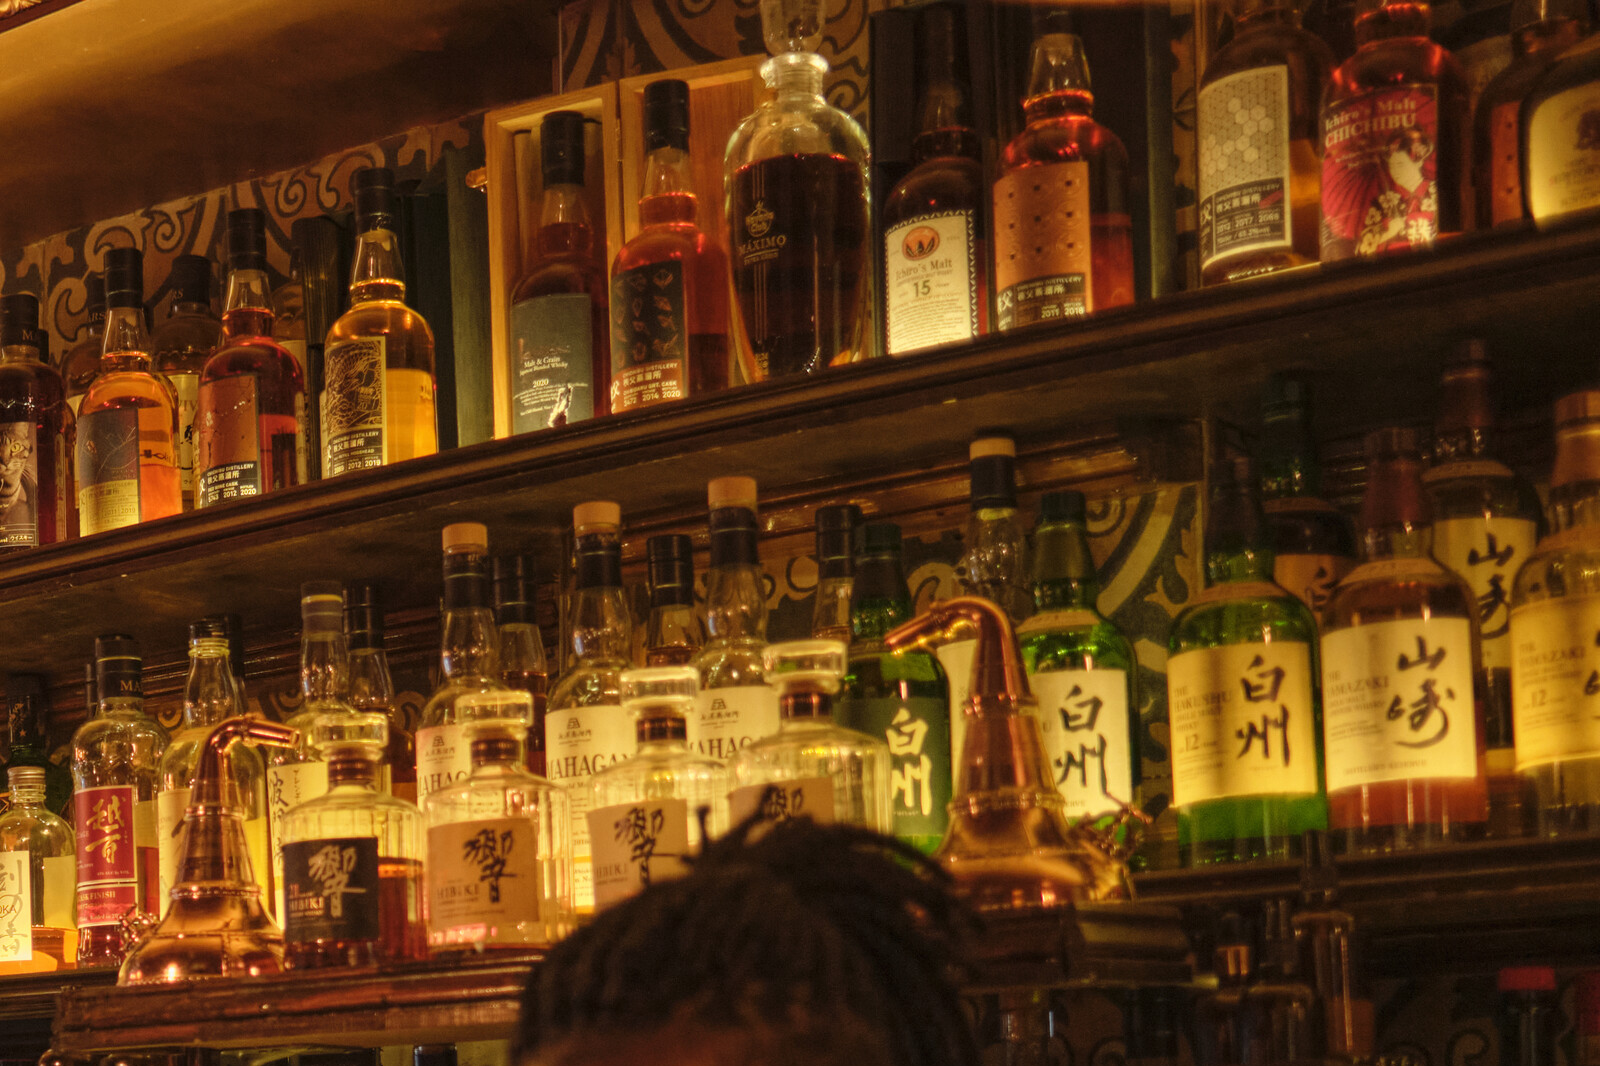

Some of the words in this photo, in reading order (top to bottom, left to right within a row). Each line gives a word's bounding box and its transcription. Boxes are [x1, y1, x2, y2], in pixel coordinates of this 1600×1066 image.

[1325, 112, 1417, 149] CHICHIBU
[931, 258, 953, 270] Malt
[913, 280, 931, 297] 15
[1041, 308, 1060, 319] 2011
[1064, 305, 1085, 316] 2018
[532, 378, 549, 388] 2020
[662, 390, 681, 399] 2020
[223, 490, 237, 498] 2012
[240, 488, 257, 496] 2020
[120, 680, 140, 692] MA
[1387, 634, 1455, 749] 山崎
[1235, 654, 1290, 768] 白州
[1056, 685, 1108, 793] 白州
[1185, 734, 1200, 752] 12
[886, 707, 932, 816] 白州
[84, 795, 125, 864] 越百
[463, 827, 517, 903] 響
[307, 845, 367, 918] 響
[89, 890, 116, 899] FINISH
[289, 896, 324, 911] HIBIKI
